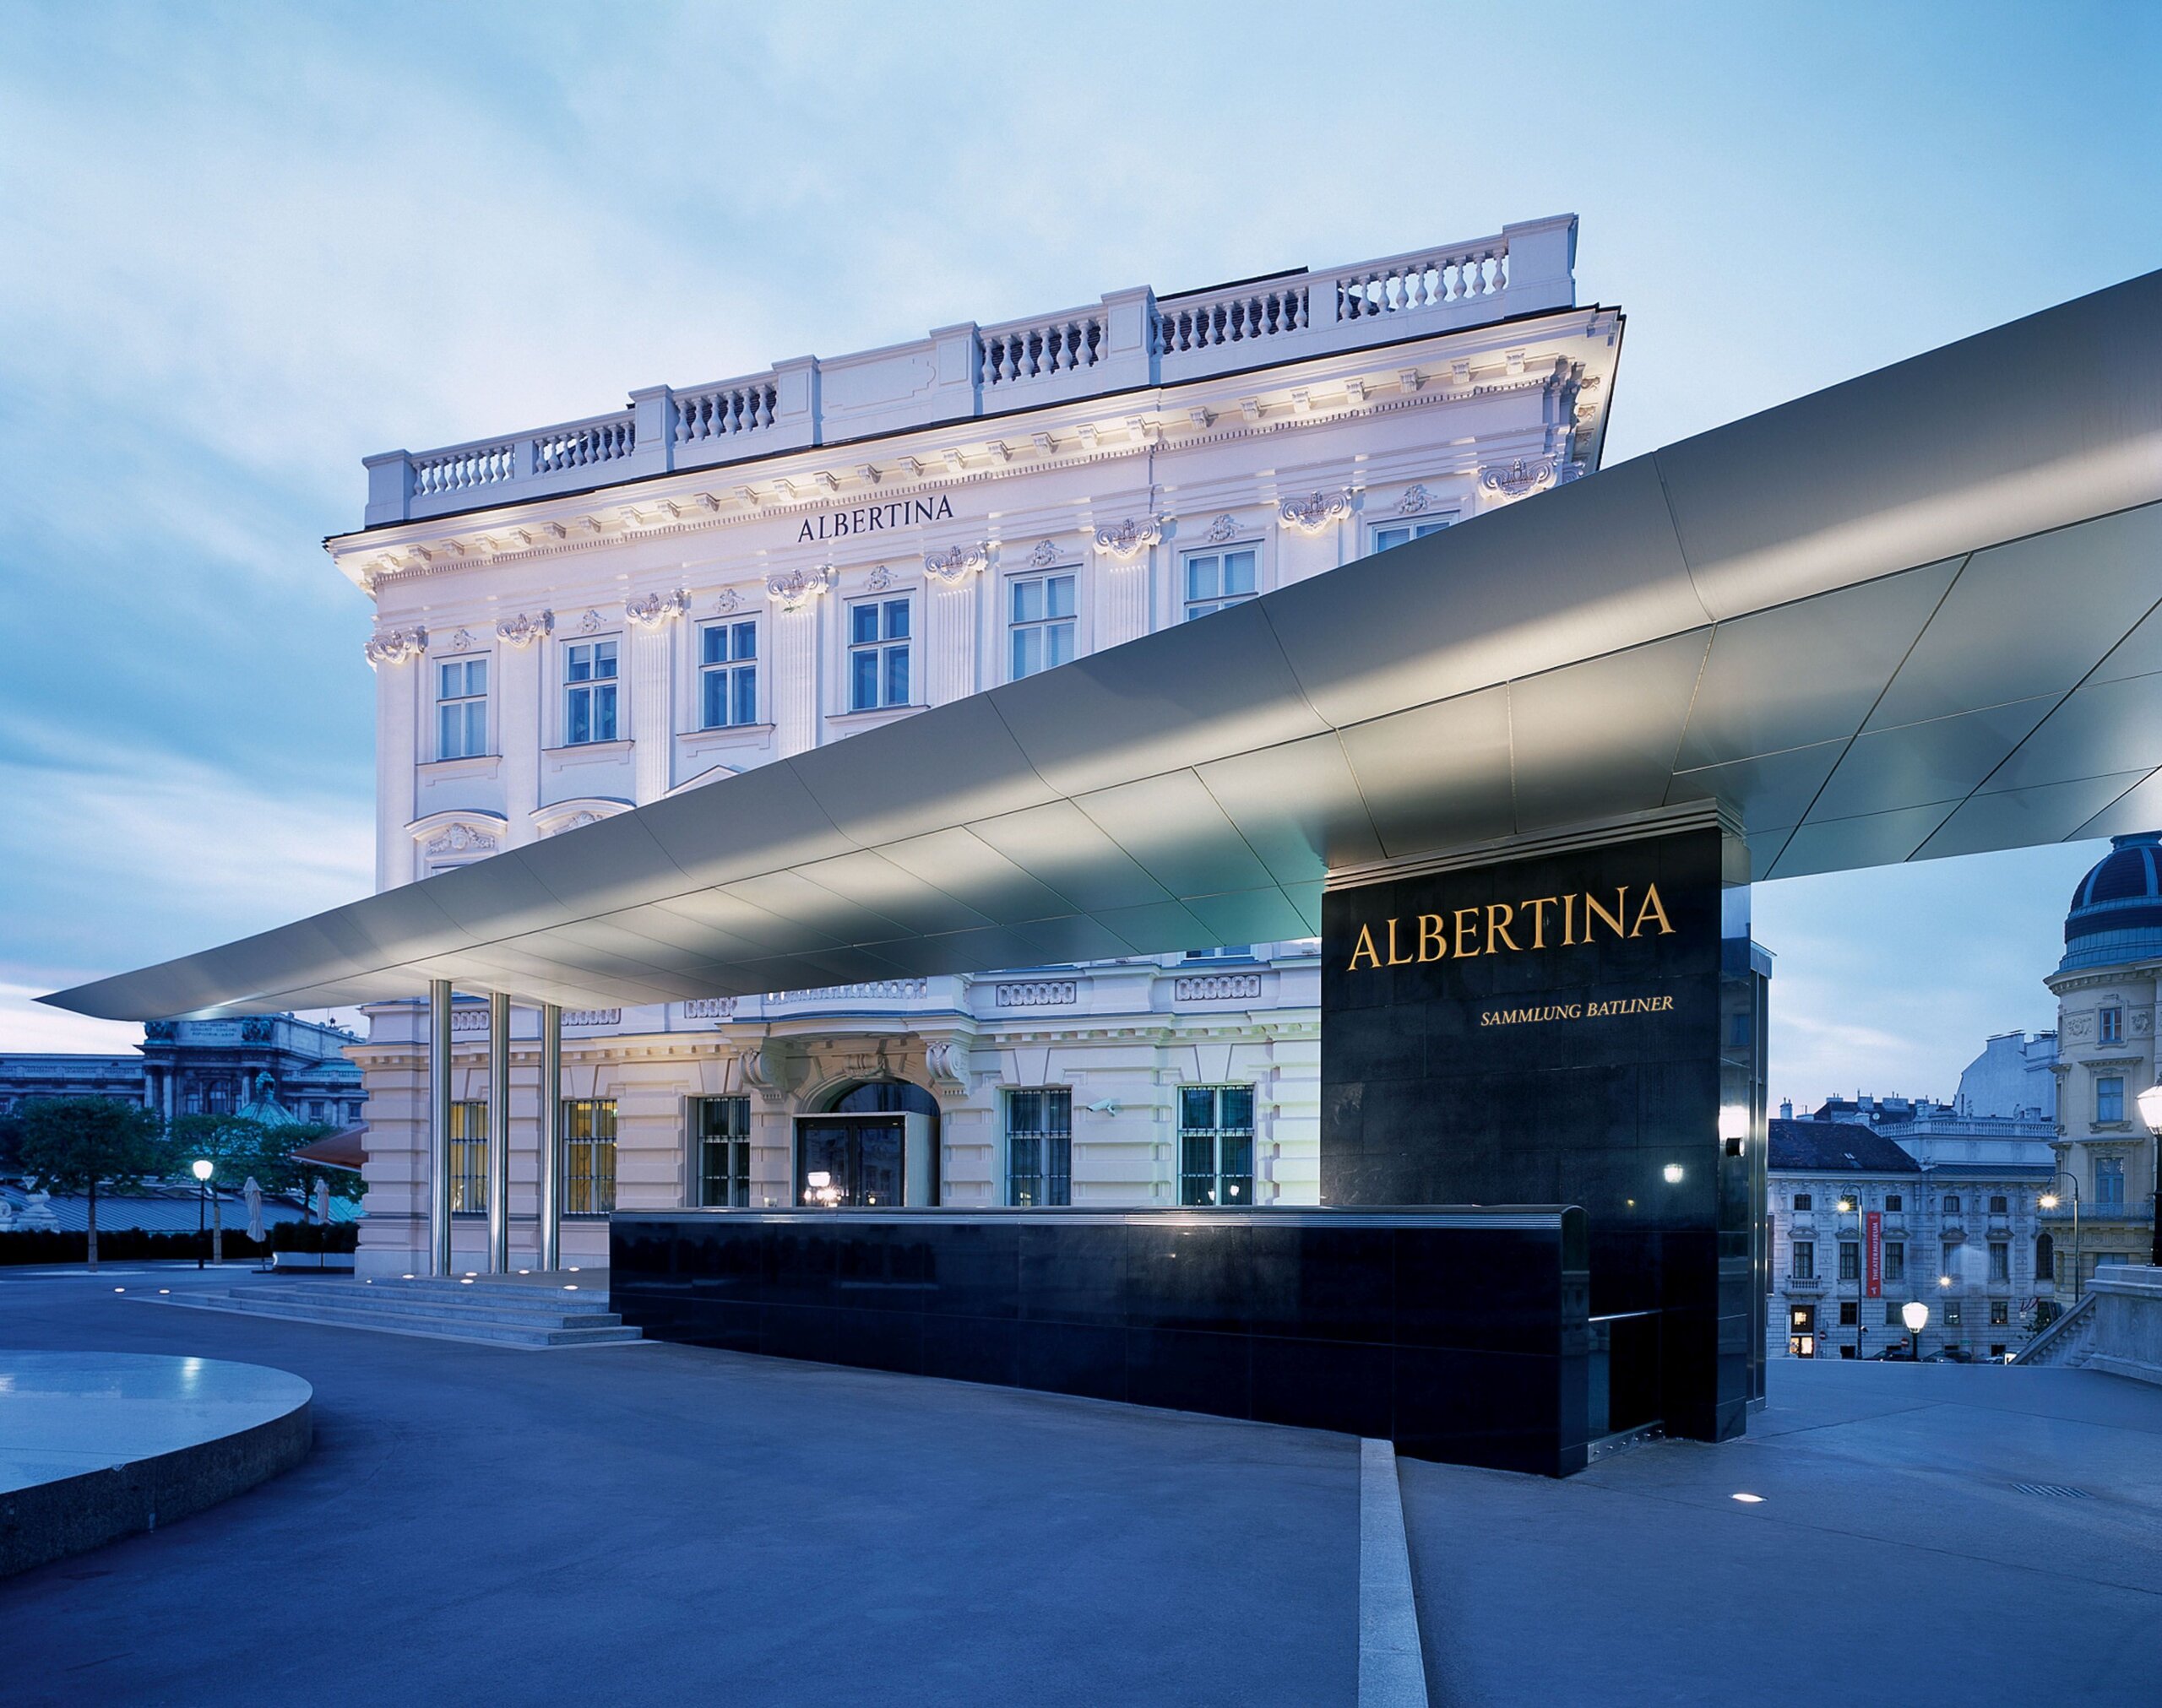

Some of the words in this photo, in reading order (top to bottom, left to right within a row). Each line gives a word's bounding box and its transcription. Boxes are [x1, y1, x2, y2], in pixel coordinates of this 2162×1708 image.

[797, 495, 953, 543] ALBERTINA
[1346, 882, 1676, 972] ALBERTINA
[1480, 1004, 1582, 1026] SAMMLUNG
[1586, 995, 1674, 1017] BATLINER
